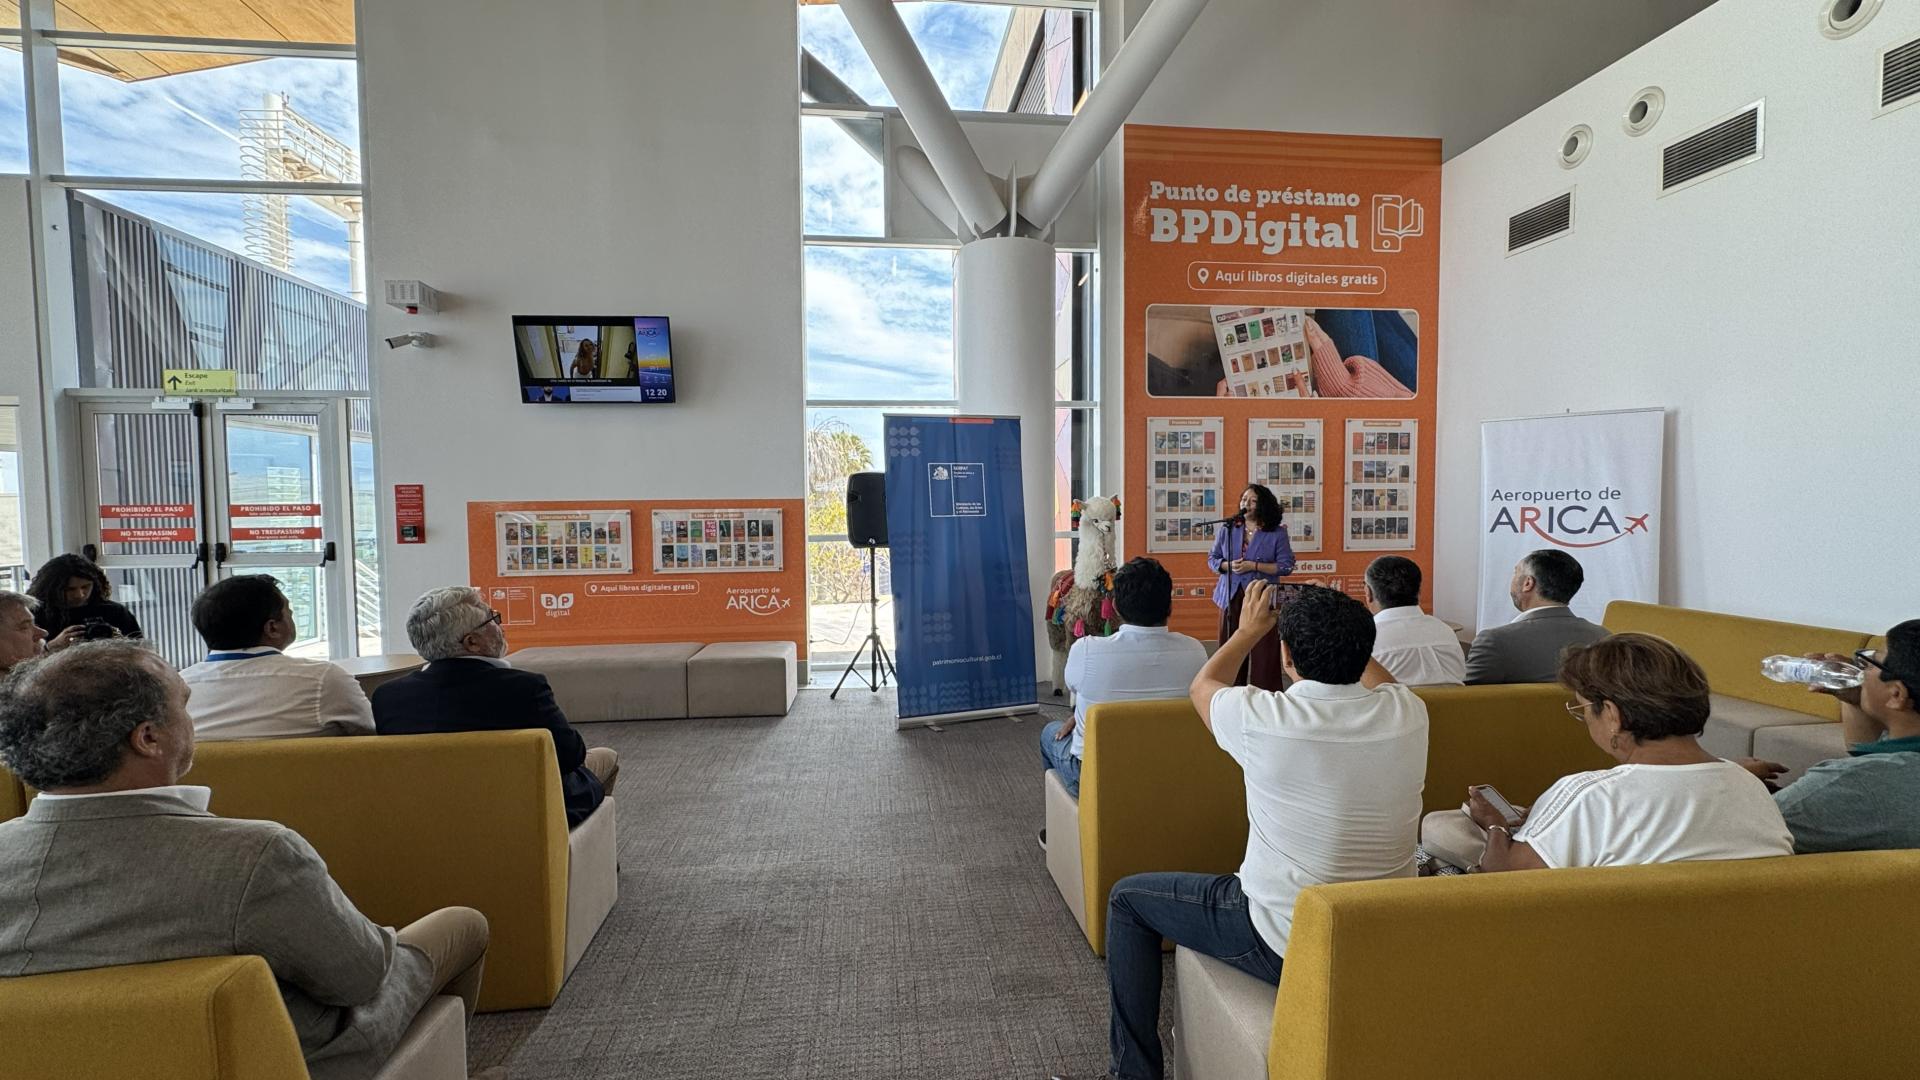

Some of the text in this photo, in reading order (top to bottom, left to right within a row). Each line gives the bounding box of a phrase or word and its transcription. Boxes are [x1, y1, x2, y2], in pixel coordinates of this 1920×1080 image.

[1150, 181, 1360, 208] Punto de préstamo
[1150, 207, 1359, 255] BPDigital
[1215, 269, 1378, 288] Aquí libros digitales gratis
[184, 372, 208, 380] Escape
[644, 388, 668, 397] 12 20
[1491, 487, 1621, 504] Aeropuerto de
[1489, 505, 1621, 536] ARICA
[1301, 562, 1313, 571] de
[1315, 562, 1333, 571] uso
[601, 583, 695, 593] Aquí libros digitales gratis
[726, 586, 781, 596] Aeropuerto de
[544, 595, 571, 607] BP
[726, 594, 781, 610] ARICA
[545, 609, 571, 618] digital
[932, 654, 1002, 667] patrimoniocultural.gob.cl
